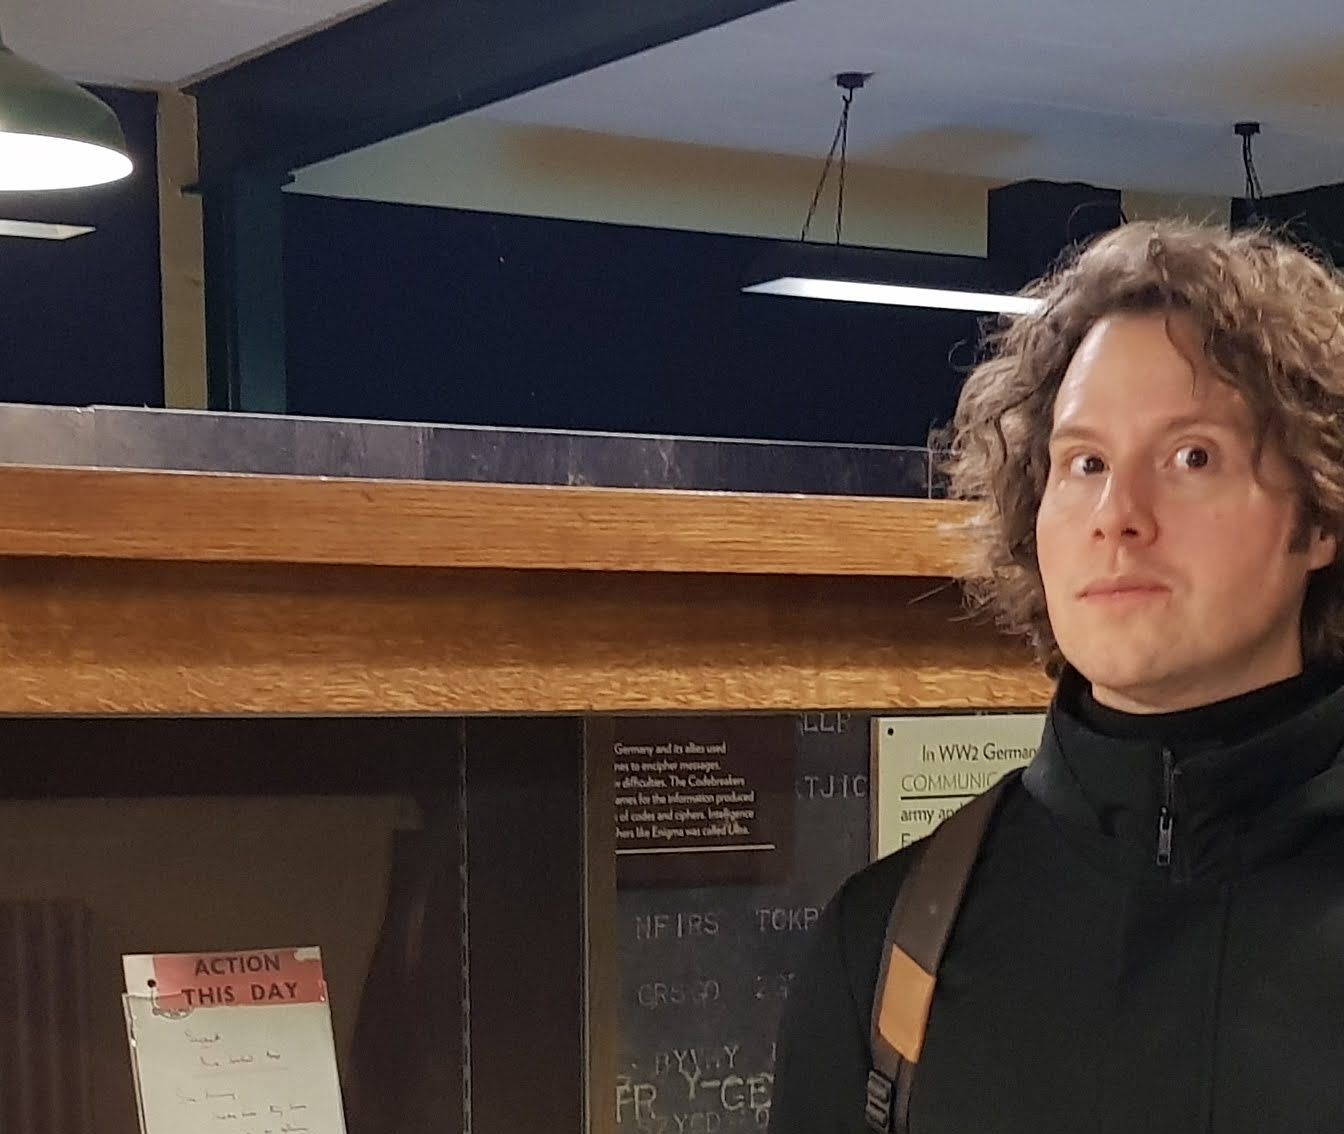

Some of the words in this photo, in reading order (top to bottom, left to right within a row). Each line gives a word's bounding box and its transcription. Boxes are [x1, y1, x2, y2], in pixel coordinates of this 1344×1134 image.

[614, 742, 654, 756] Germany
[656, 743, 672, 754] and
[707, 741, 726, 754] used
[922, 744, 935, 761] In
[938, 743, 978, 761] WW2
[630, 762, 640, 772] to
[641, 759, 678, 773] encipher
[669, 775, 686, 787] The
[687, 774, 745, 787] Codebreakers
[638, 792, 650, 804] for
[652, 793, 666, 804] the
[667, 792, 714, 804] information
[716, 790, 754, 804] produced
[619, 809, 629, 821] of
[630, 809, 655, 821] codes
[657, 809, 673, 820] and
[900, 808, 934, 825] army
[636, 826, 651, 838] like
[652, 825, 684, 840] Enigma
[685, 828, 700, 837] was
[702, 824, 726, 837] called
[195, 954, 280, 976] ACTION
[181, 985, 235, 1005] THIS
[251, 982, 297, 1000] DAY
